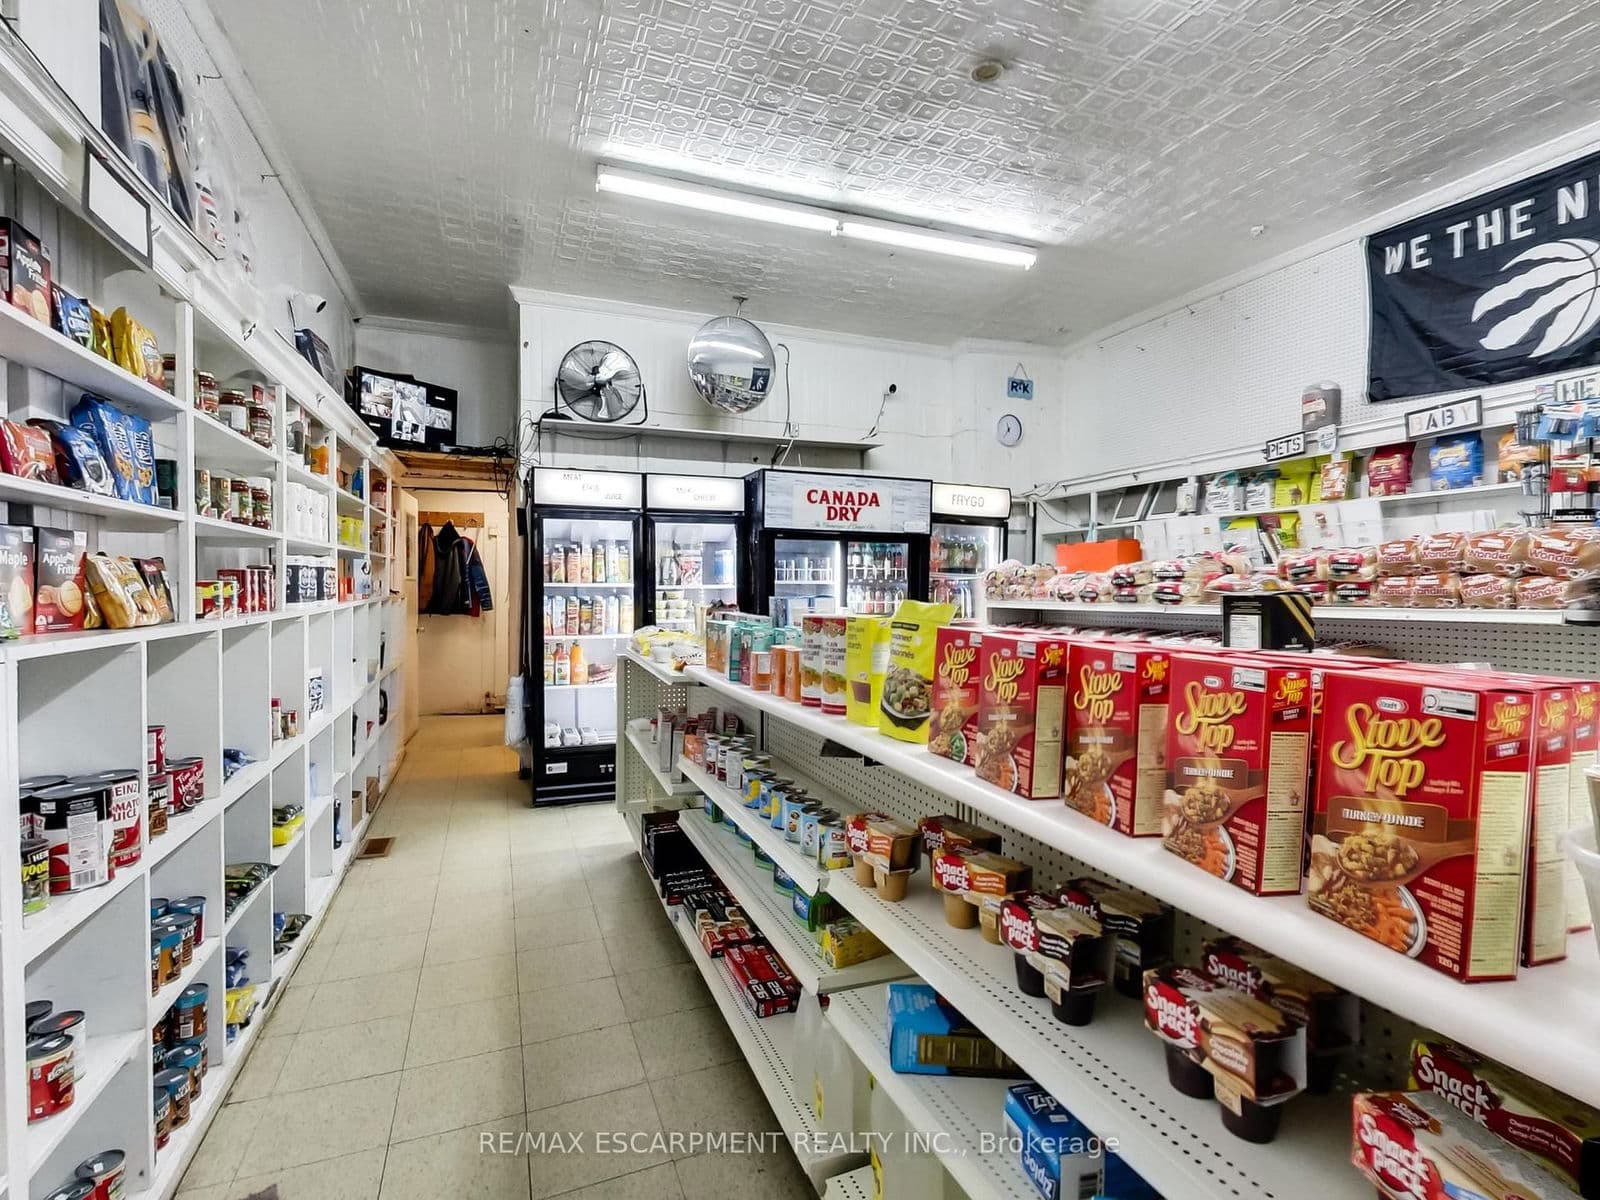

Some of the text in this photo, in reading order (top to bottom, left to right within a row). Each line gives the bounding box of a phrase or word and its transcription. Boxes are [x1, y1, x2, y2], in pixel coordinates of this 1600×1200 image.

[1385, 233, 1432, 275] WE
[1446, 199, 1536, 258] THE
[1270, 437, 1300, 456] PETS
[807, 489, 880, 506] CANADA
[952, 494, 985, 508] FRYGO
[826, 506, 862, 521] DRY
[0, 550, 28, 568] Maple
[1468, 549, 1511, 560] Wonder
[1530, 549, 1579, 565] Wonder
[1463, 582, 1505, 598] Wonder
[939, 642, 976, 677] Stove
[984, 650, 1025, 692] Stove
[949, 668, 970, 687] Top
[996, 679, 1018, 704] Top
[1074, 664, 1123, 710] Stove
[1088, 695, 1114, 724] Top
[1176, 681, 1247, 735] Stove
[1196, 717, 1234, 754] Top
[1330, 702, 1446, 769] Stove
[1364, 752, 1426, 796] Top
[935, 858, 970, 880] Snack
[942, 873, 970, 891] pack
[1060, 894, 1098, 920] Snack
[1002, 907, 1036, 938] Snack
[1008, 928, 1035, 951] pack
[1208, 954, 1258, 989] Snack
[1148, 985, 1199, 1026] Snack
[1158, 1011, 1198, 1049] pack
[1417, 1055, 1496, 1111] Snack
[1360, 1113, 1430, 1183] Snack
